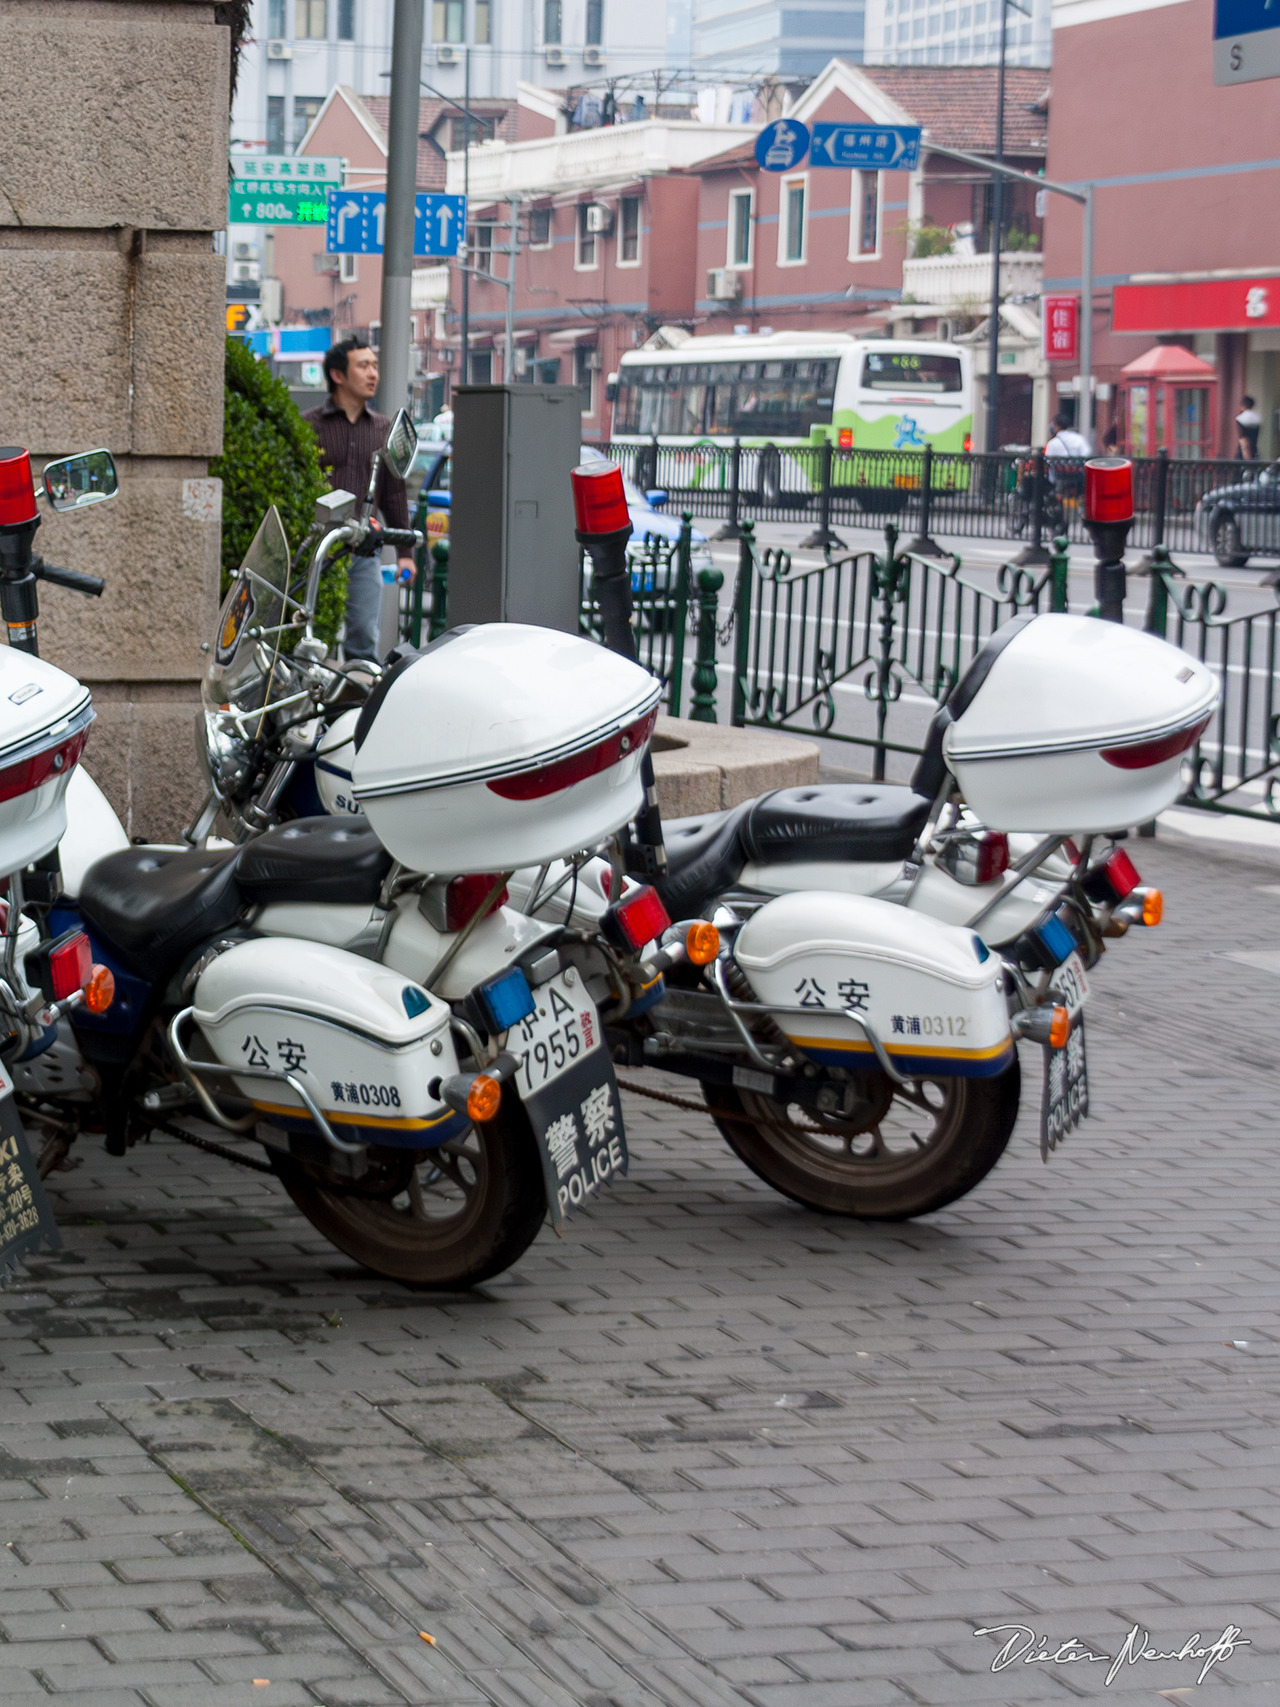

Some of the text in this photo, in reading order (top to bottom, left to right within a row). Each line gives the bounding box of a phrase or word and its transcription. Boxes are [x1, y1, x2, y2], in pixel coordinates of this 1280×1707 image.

[335, 794, 365, 815] SU
[794, 977, 871, 1011] 公安
[890, 1014, 968, 1037] 黄浦0312
[241, 1034, 308, 1075] 公安
[330, 1080, 402, 1108] 黄浦0308
[545, 1081, 615, 1180] 警察
[557, 1135, 624, 1218] POLICE
